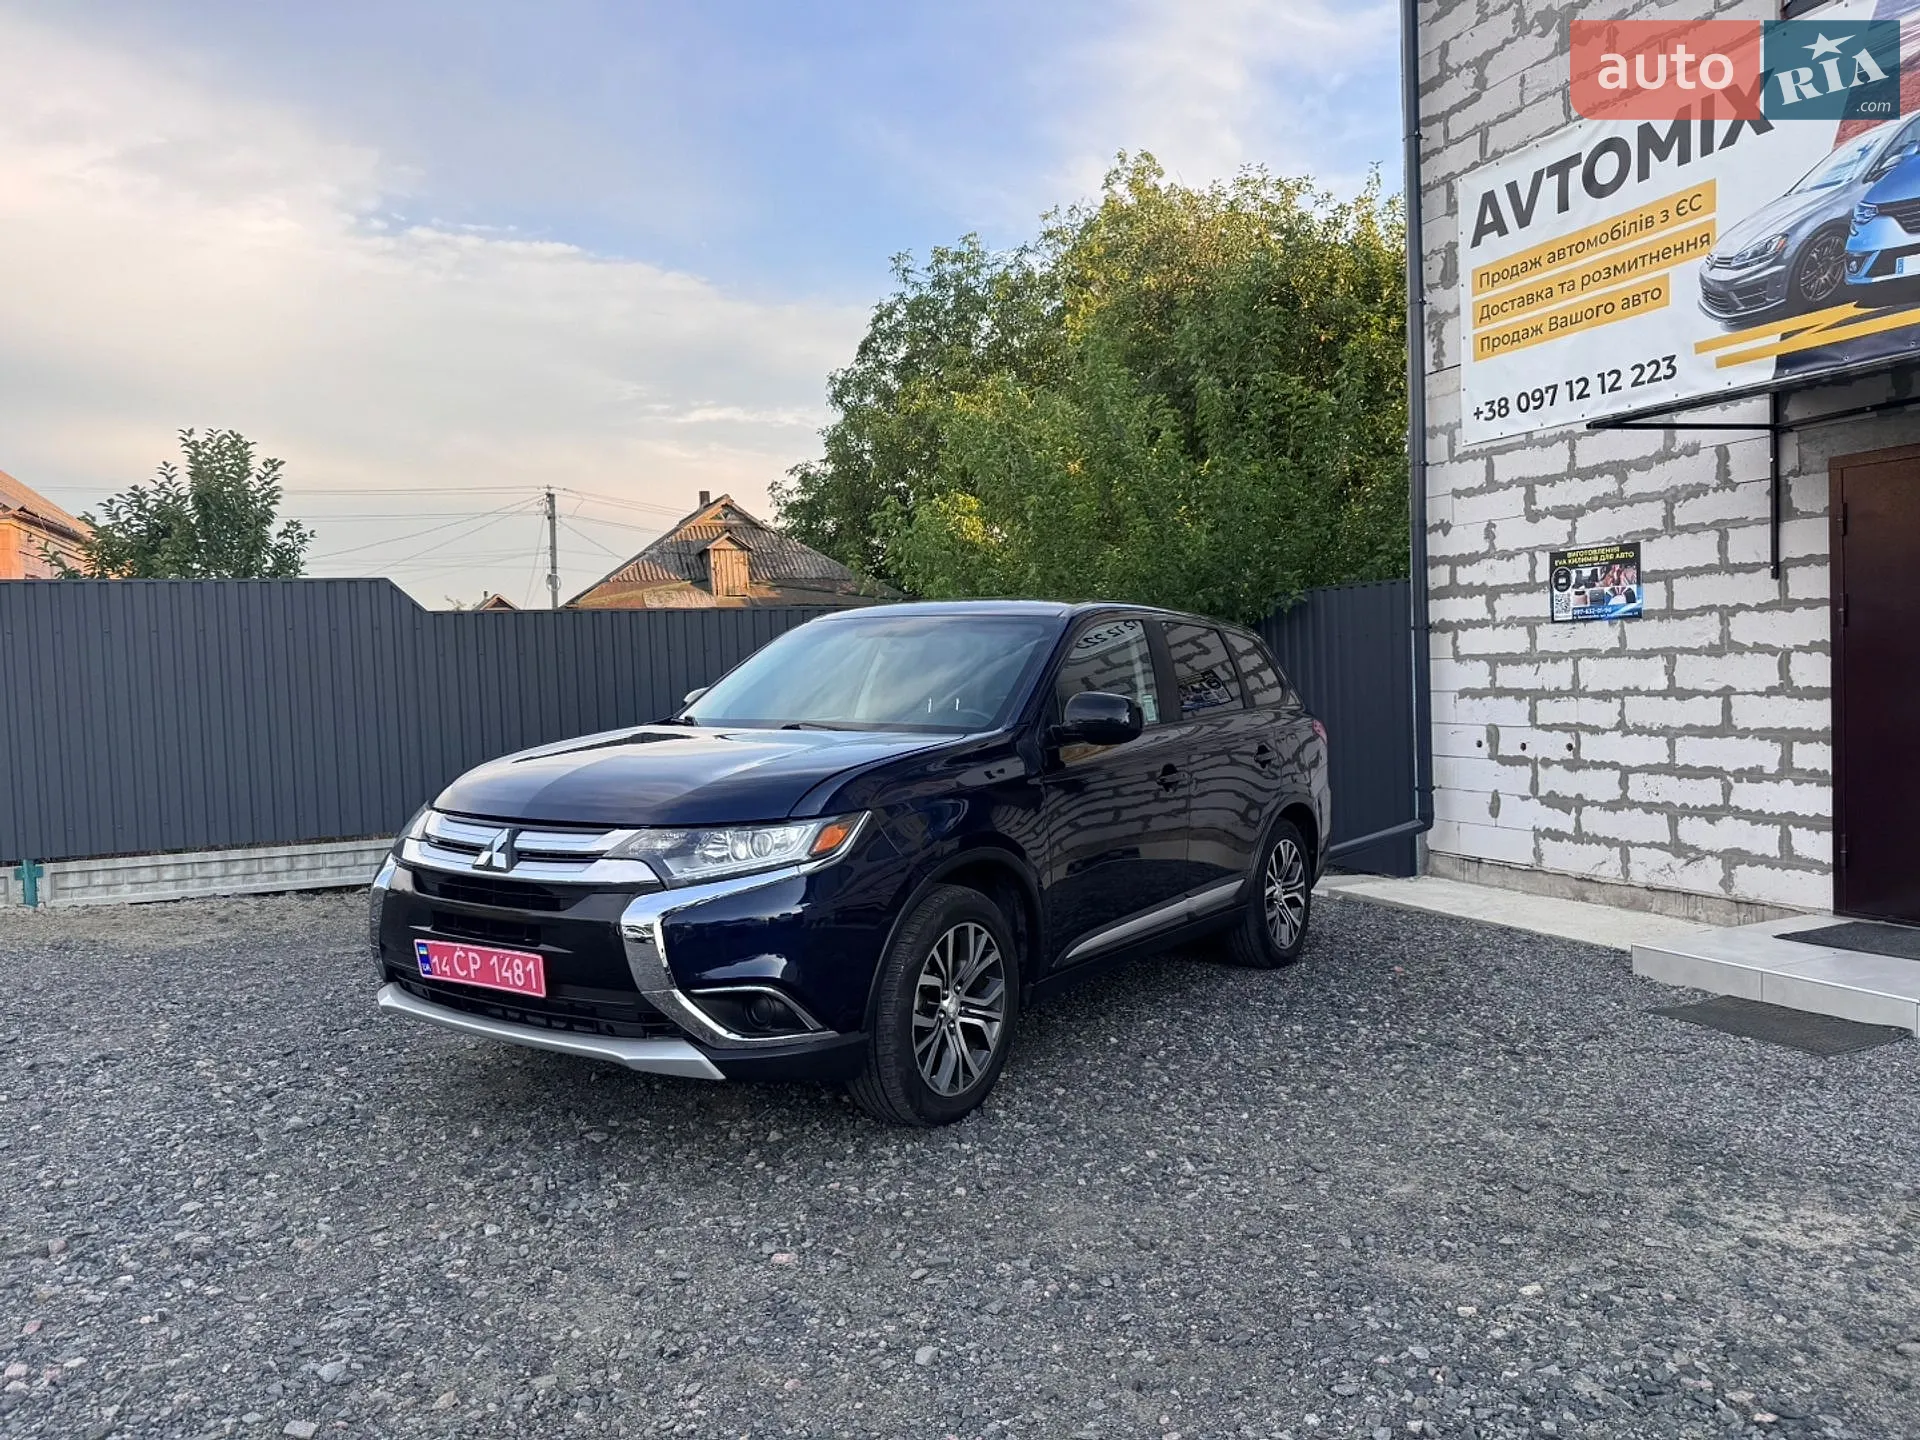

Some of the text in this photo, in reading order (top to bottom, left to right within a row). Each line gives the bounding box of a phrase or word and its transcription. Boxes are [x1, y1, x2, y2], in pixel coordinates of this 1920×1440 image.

[1470, 68, 1776, 249] AVTOMIX
[1478, 232, 1711, 323] Доставка та розмитнення
[1479, 193, 1702, 289] Продаж автомобілів з ЄС
[1480, 287, 1663, 353] Продаж Вашого авто
[1473, 354, 1678, 422] +38 097 12 12 223
[432, 955, 451, 976] 14
[490, 955, 537, 989] 1481
